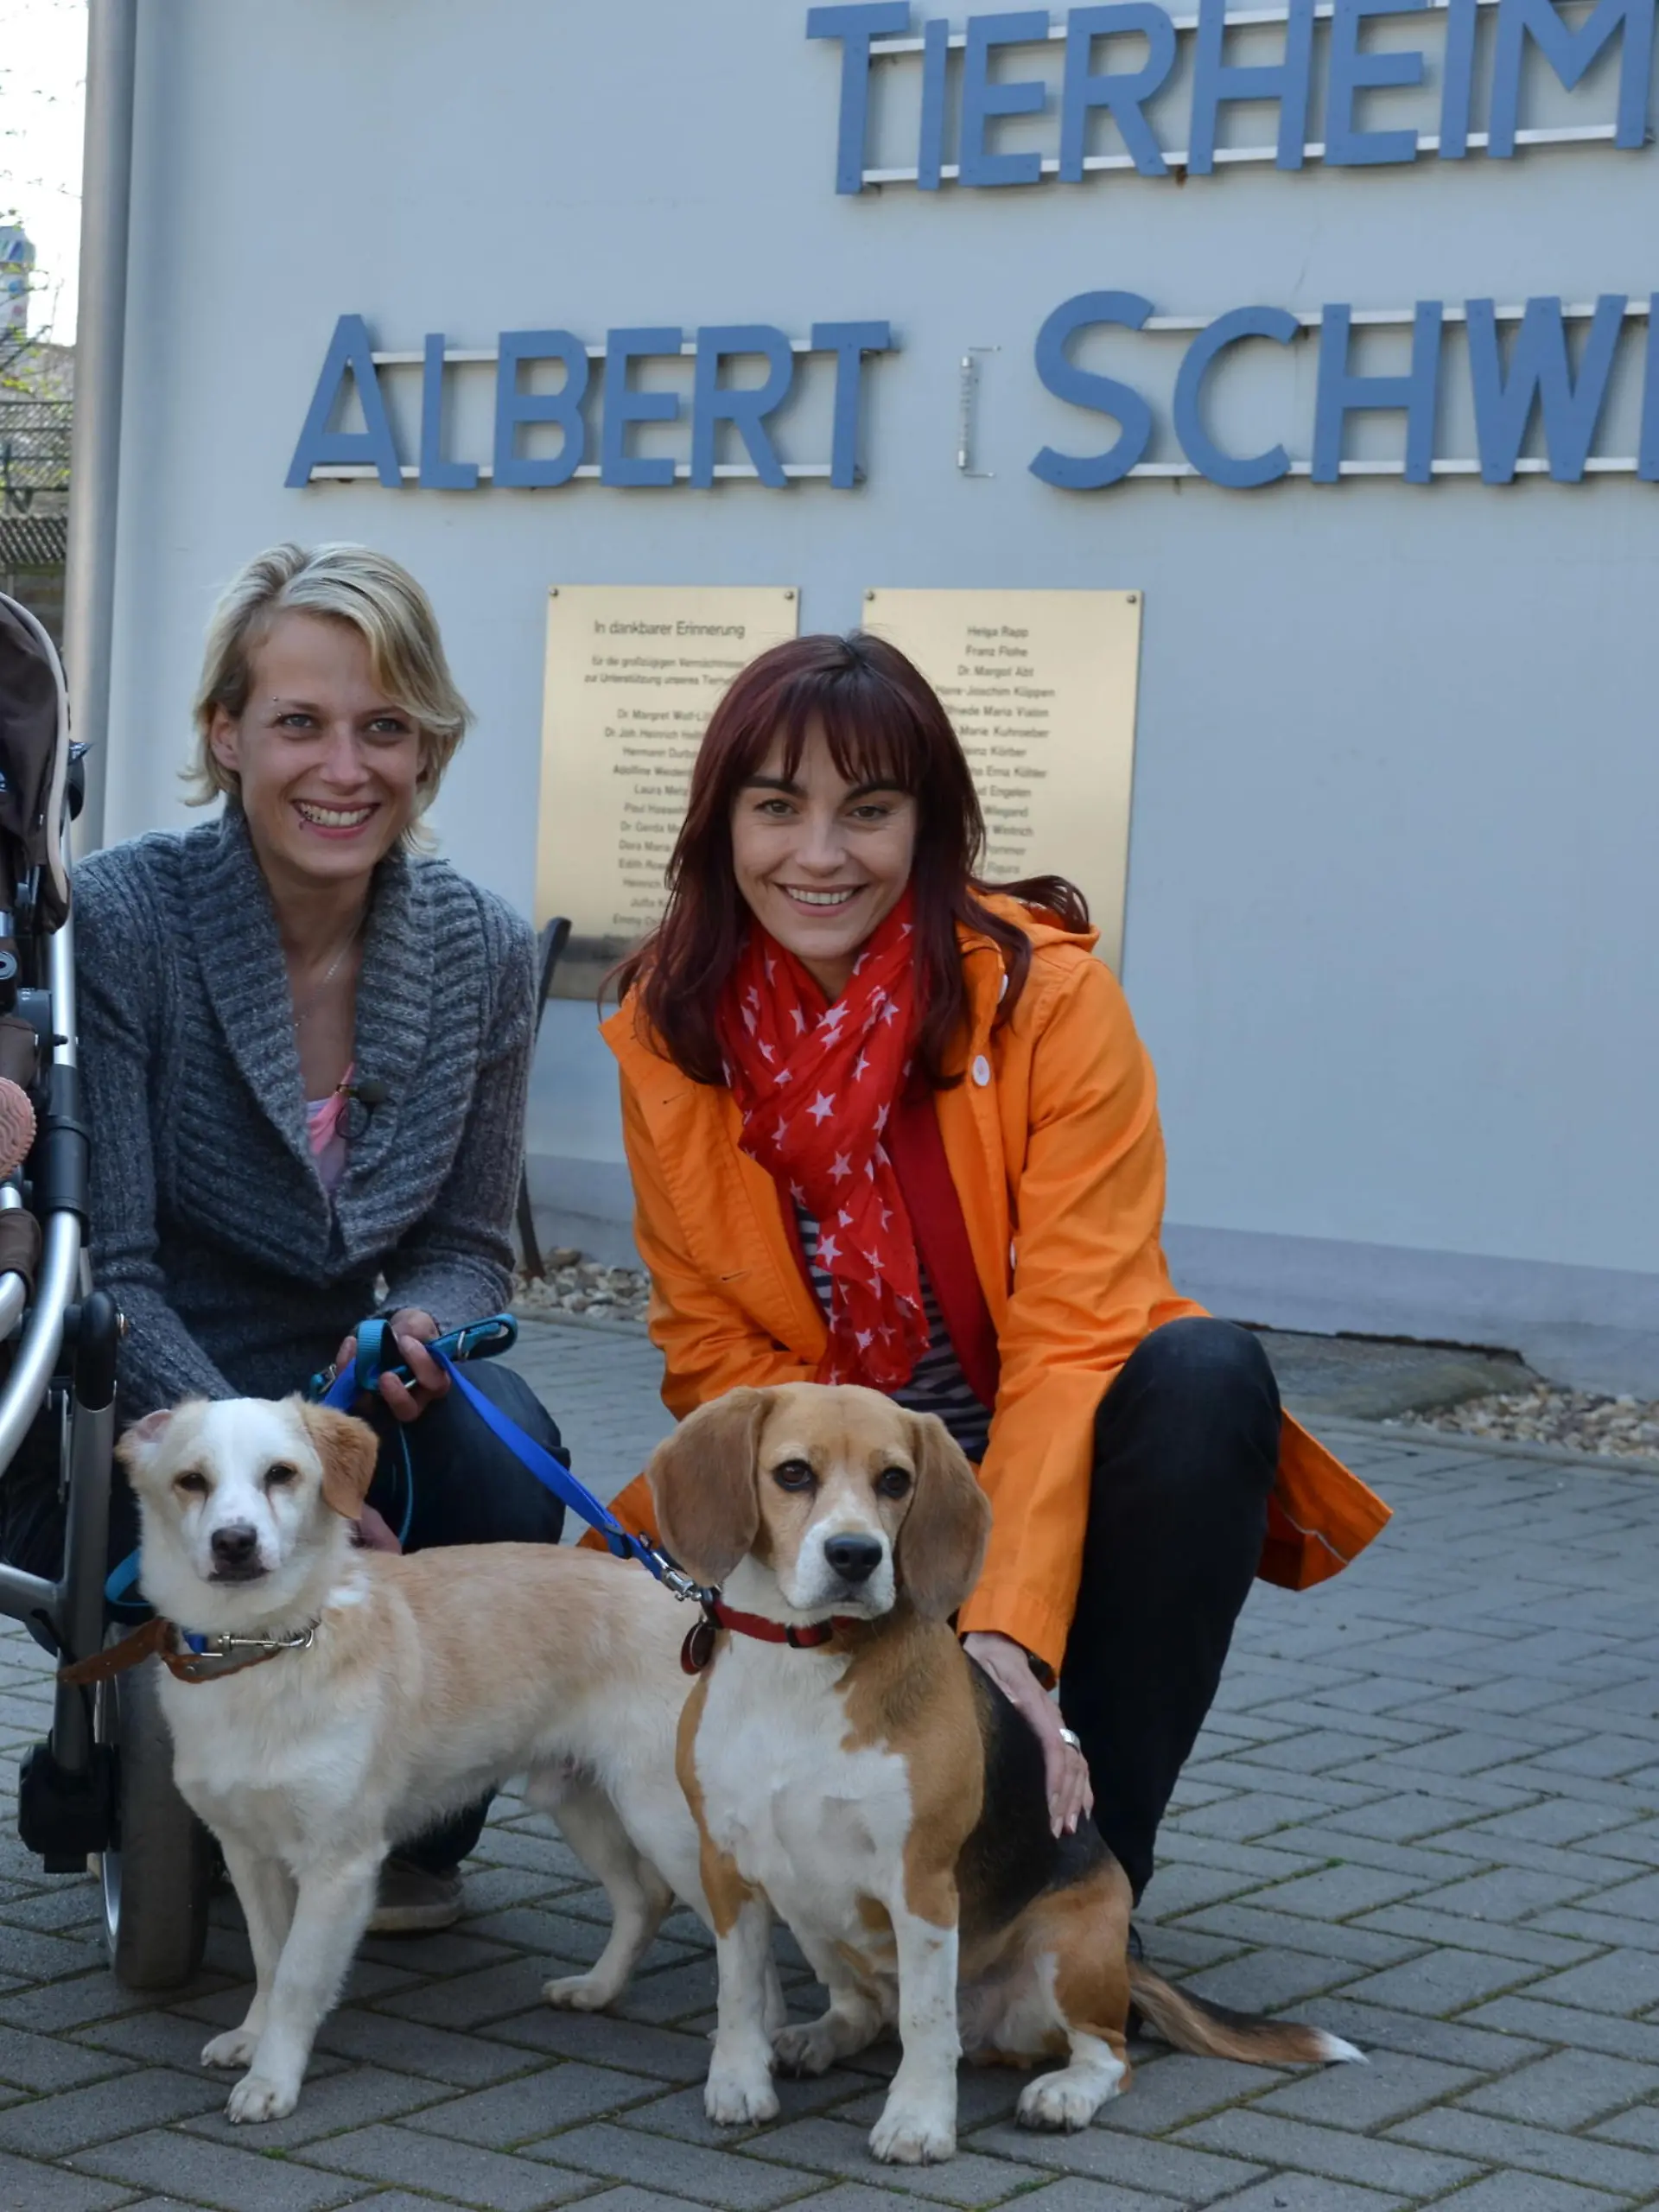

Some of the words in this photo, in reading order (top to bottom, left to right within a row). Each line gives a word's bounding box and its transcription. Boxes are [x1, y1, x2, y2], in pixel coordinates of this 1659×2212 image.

[806, 0, 1655, 195] TIERHEIM
[284, 314, 891, 490] ALBERT
[1028, 289, 1659, 490] SCHW
[594, 620, 606, 633] In
[609, 620, 672, 636] dankbarer
[676, 621, 745, 639] Erinnerung
